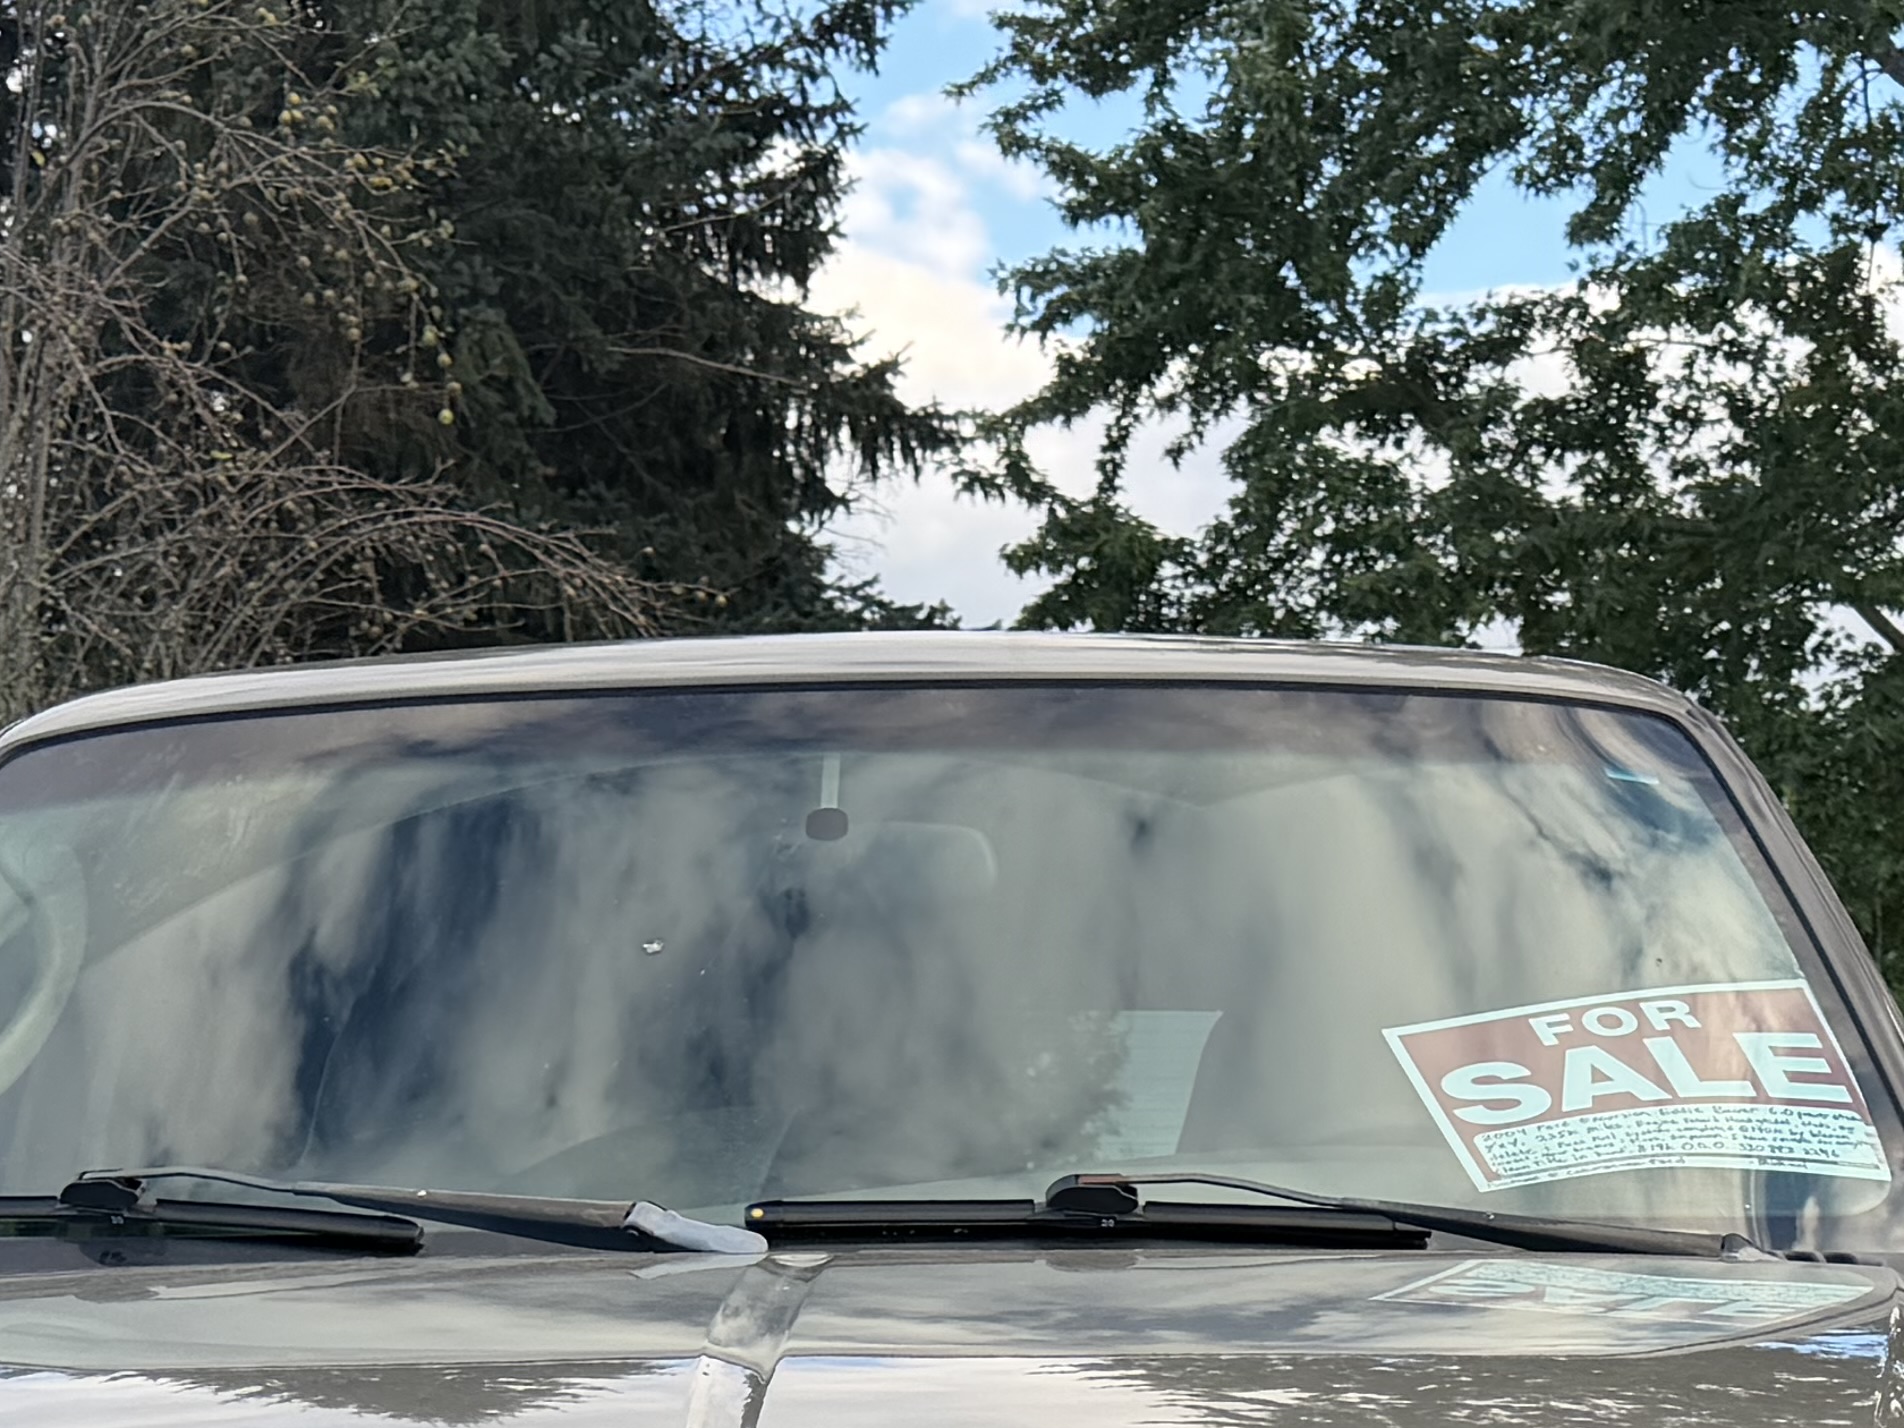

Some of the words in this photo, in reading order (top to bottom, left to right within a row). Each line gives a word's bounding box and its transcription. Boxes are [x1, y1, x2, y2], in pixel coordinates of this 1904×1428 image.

[1528, 1000, 1701, 1047] FOR
[1440, 1032, 1853, 1125] SALE
[1481, 1128, 1527, 1142] 2004
